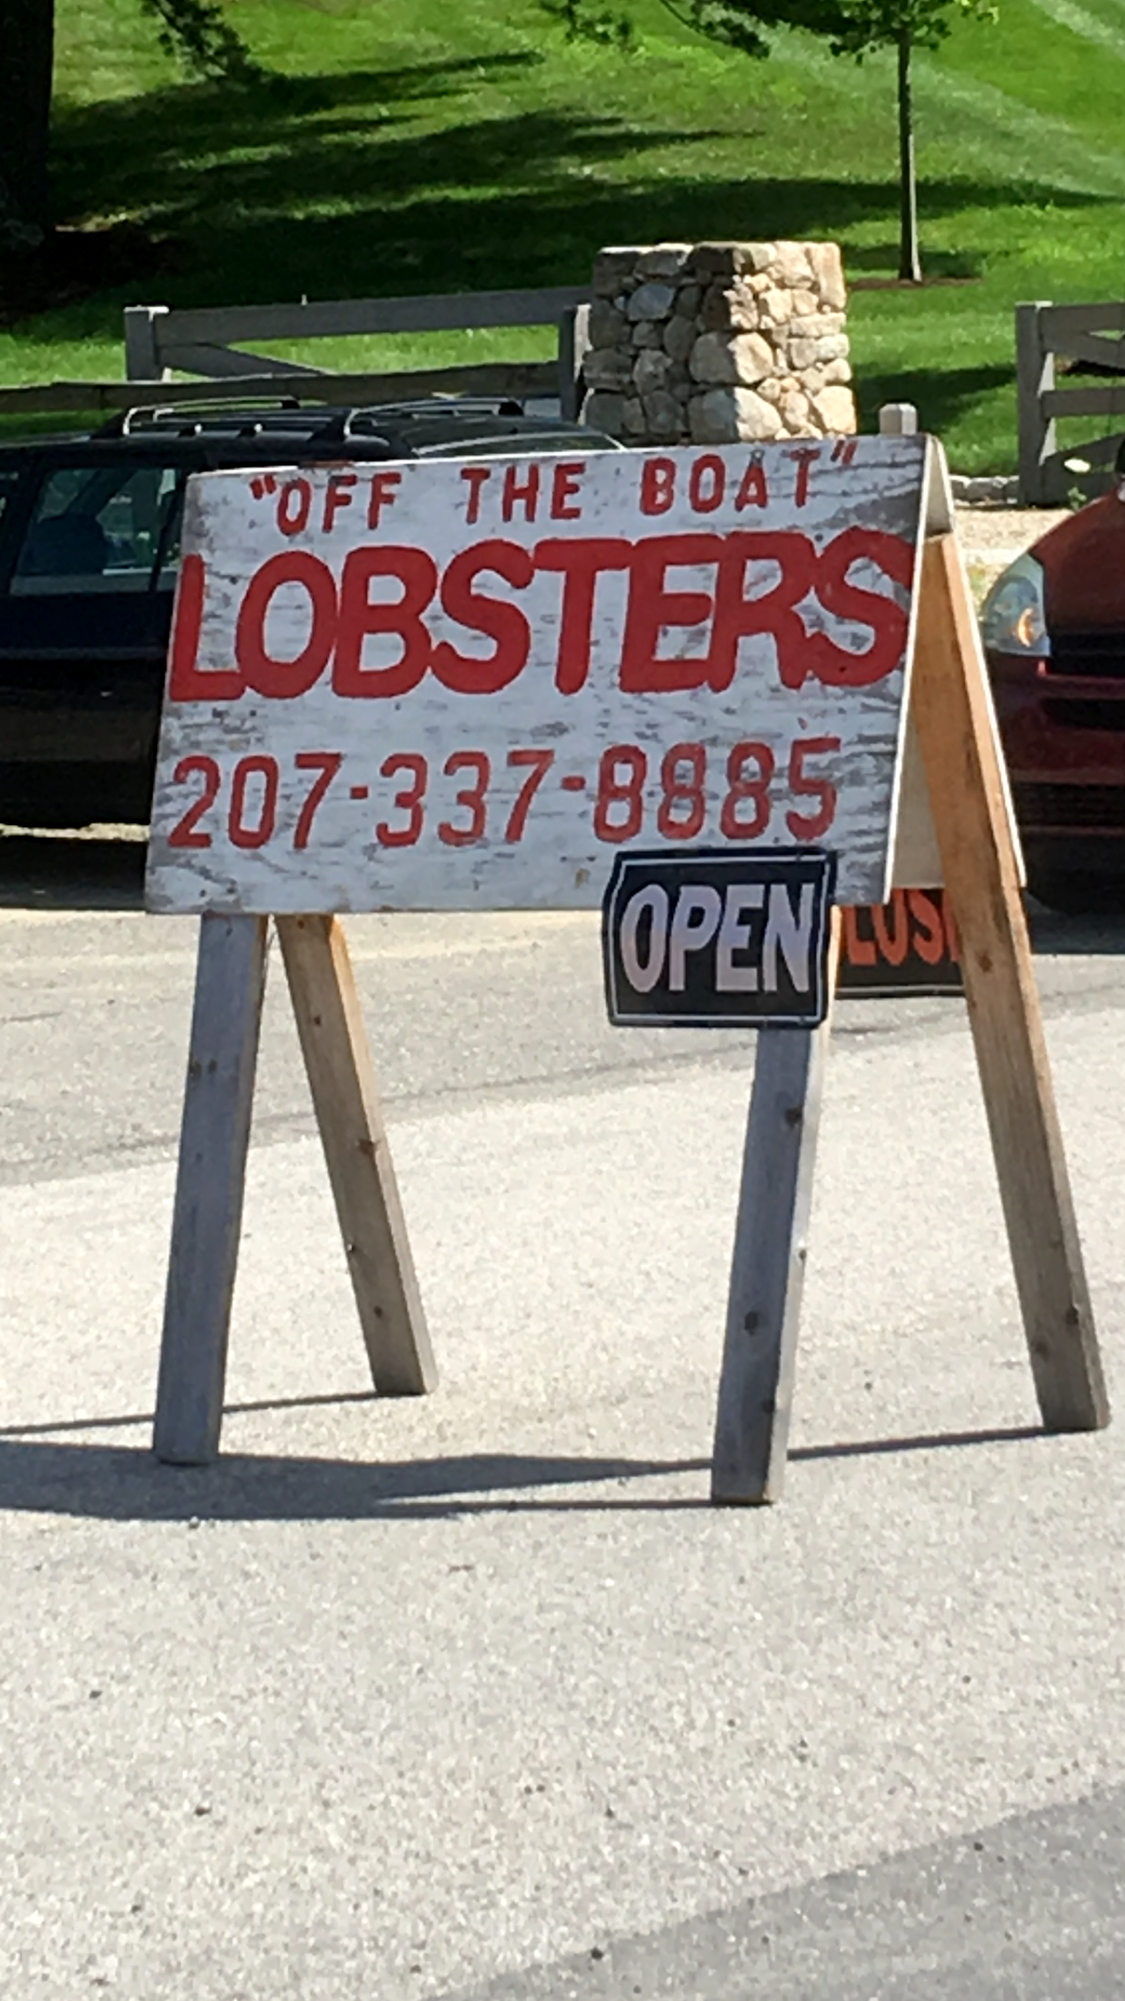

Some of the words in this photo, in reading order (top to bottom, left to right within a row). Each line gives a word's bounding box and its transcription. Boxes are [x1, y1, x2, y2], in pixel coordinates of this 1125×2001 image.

[250, 472, 401, 537] "OFF
[461, 463, 587, 524] THE
[640, 440, 856, 516] BOAT"
[168, 527, 916, 702] LOBSTERS
[167, 736, 842, 850] 207-337-8885
[620, 883, 815, 993] OPEN
